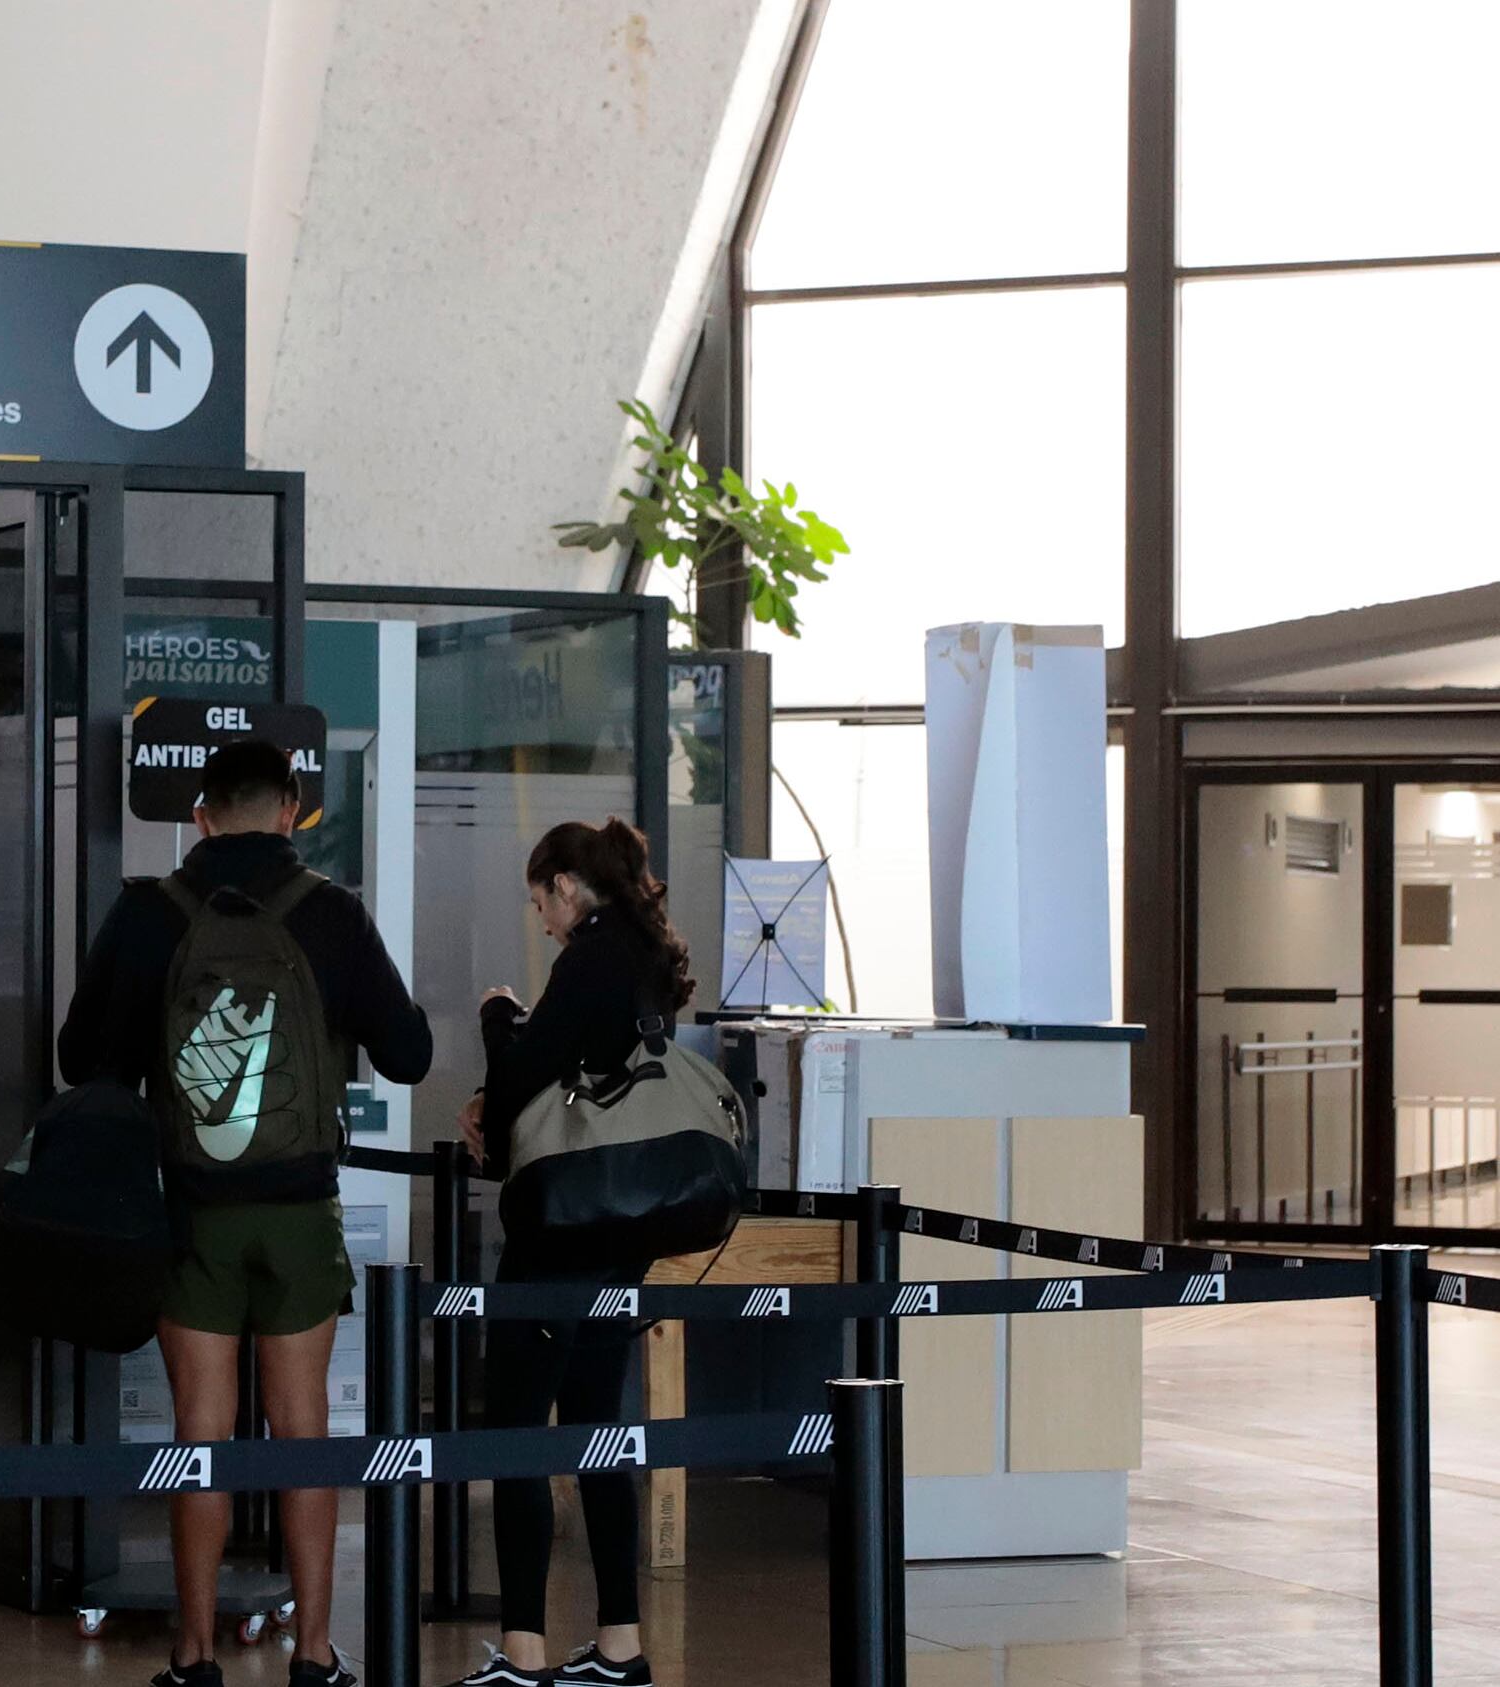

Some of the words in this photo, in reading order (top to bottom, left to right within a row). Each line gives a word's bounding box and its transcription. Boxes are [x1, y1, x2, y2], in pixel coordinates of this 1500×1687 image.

[125, 630, 239, 660] HÉROES
[124, 655, 269, 690] paisanos
[206, 707, 252, 731] GEL
[134, 744, 322, 772] ANTIBAL
